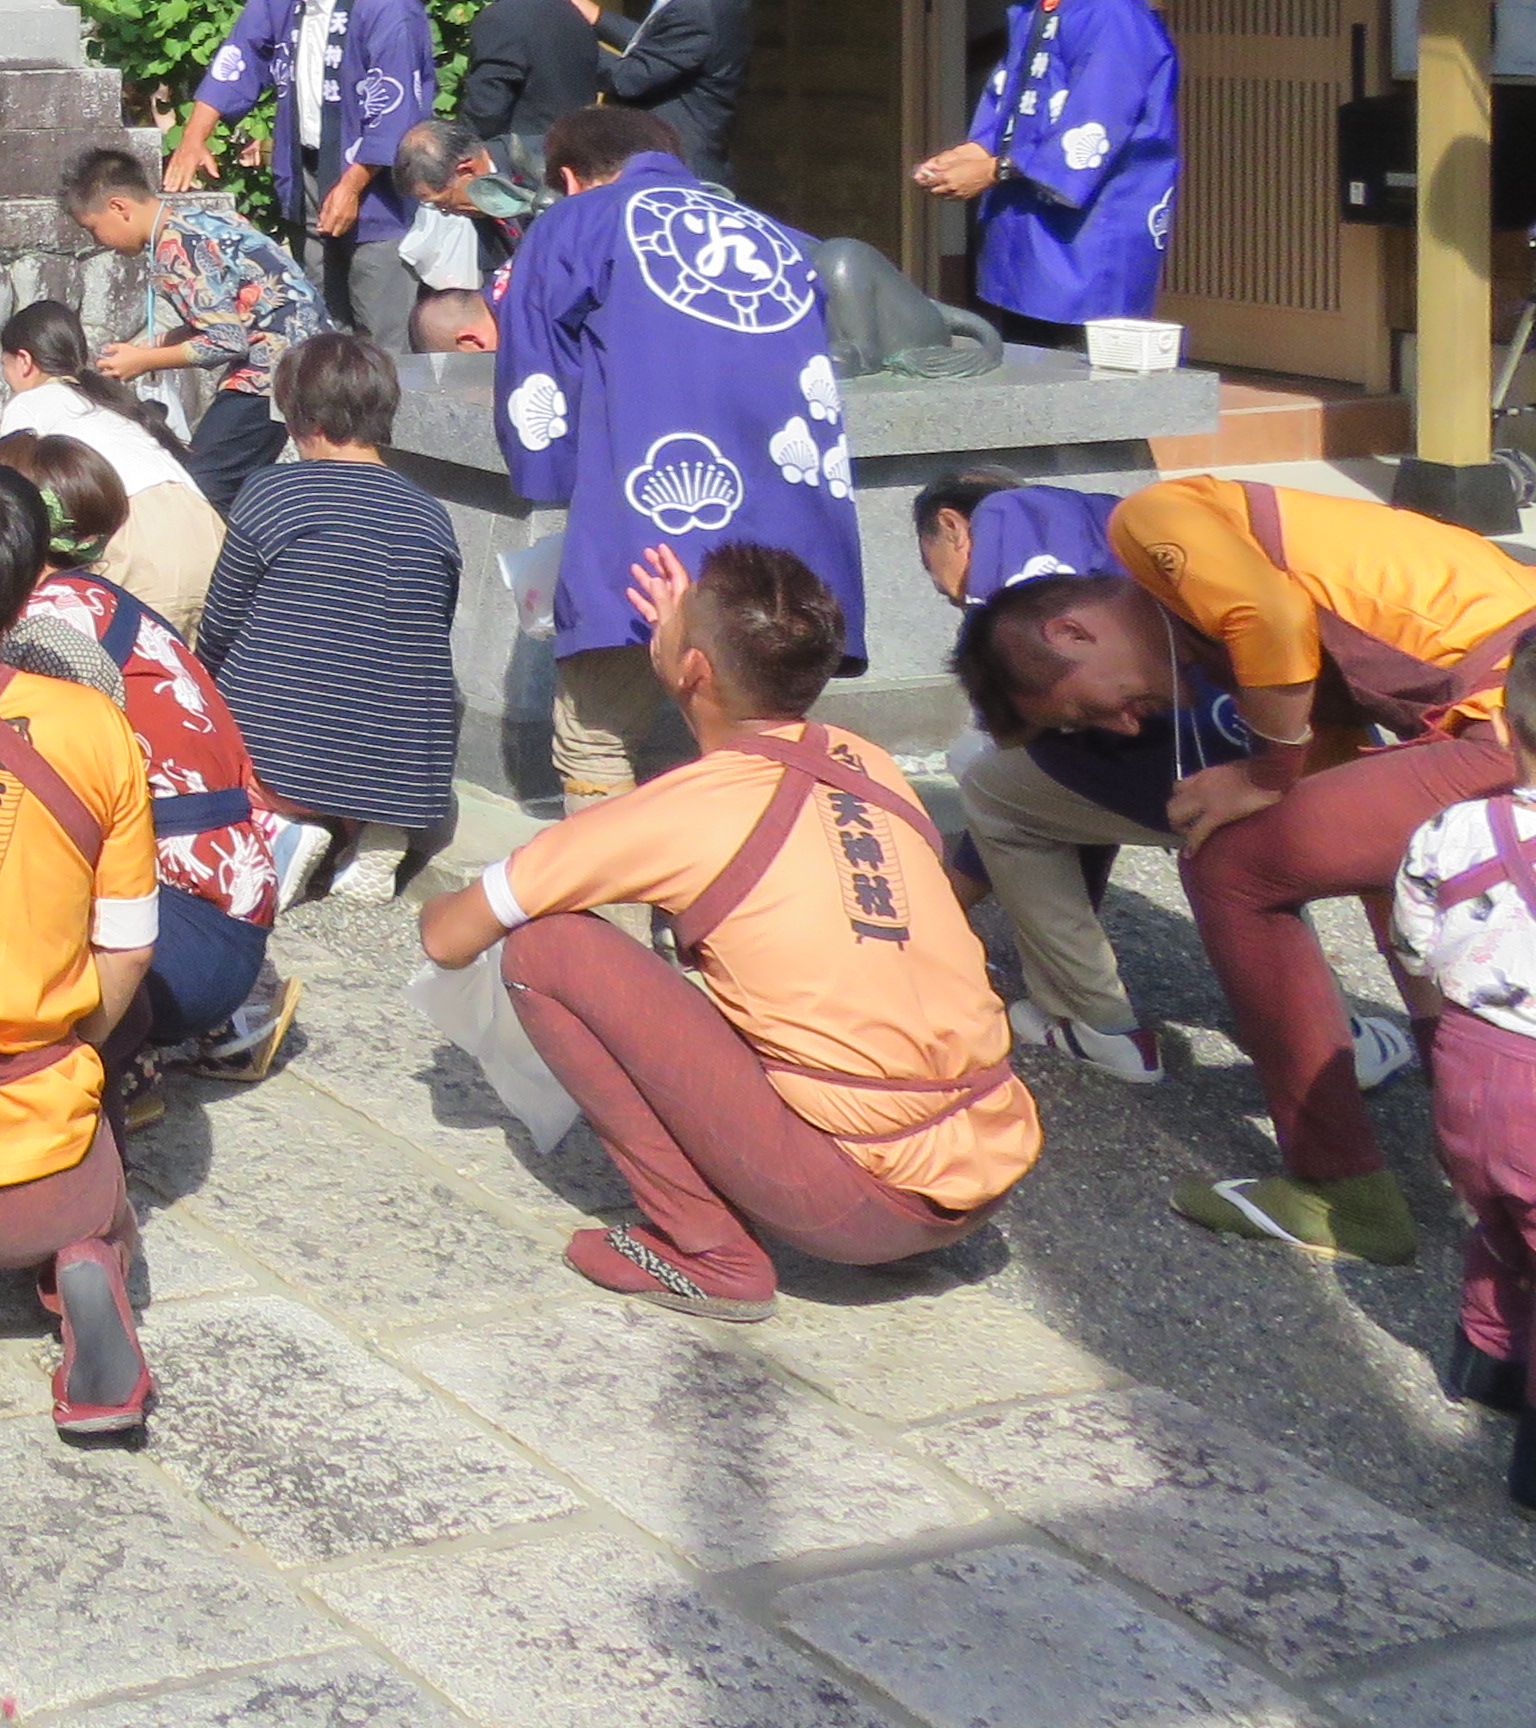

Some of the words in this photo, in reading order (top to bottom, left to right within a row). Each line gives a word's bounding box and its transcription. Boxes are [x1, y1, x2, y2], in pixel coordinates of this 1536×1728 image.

[322, 10, 350, 103] 天神社
[827, 791, 898, 920] 天神社
